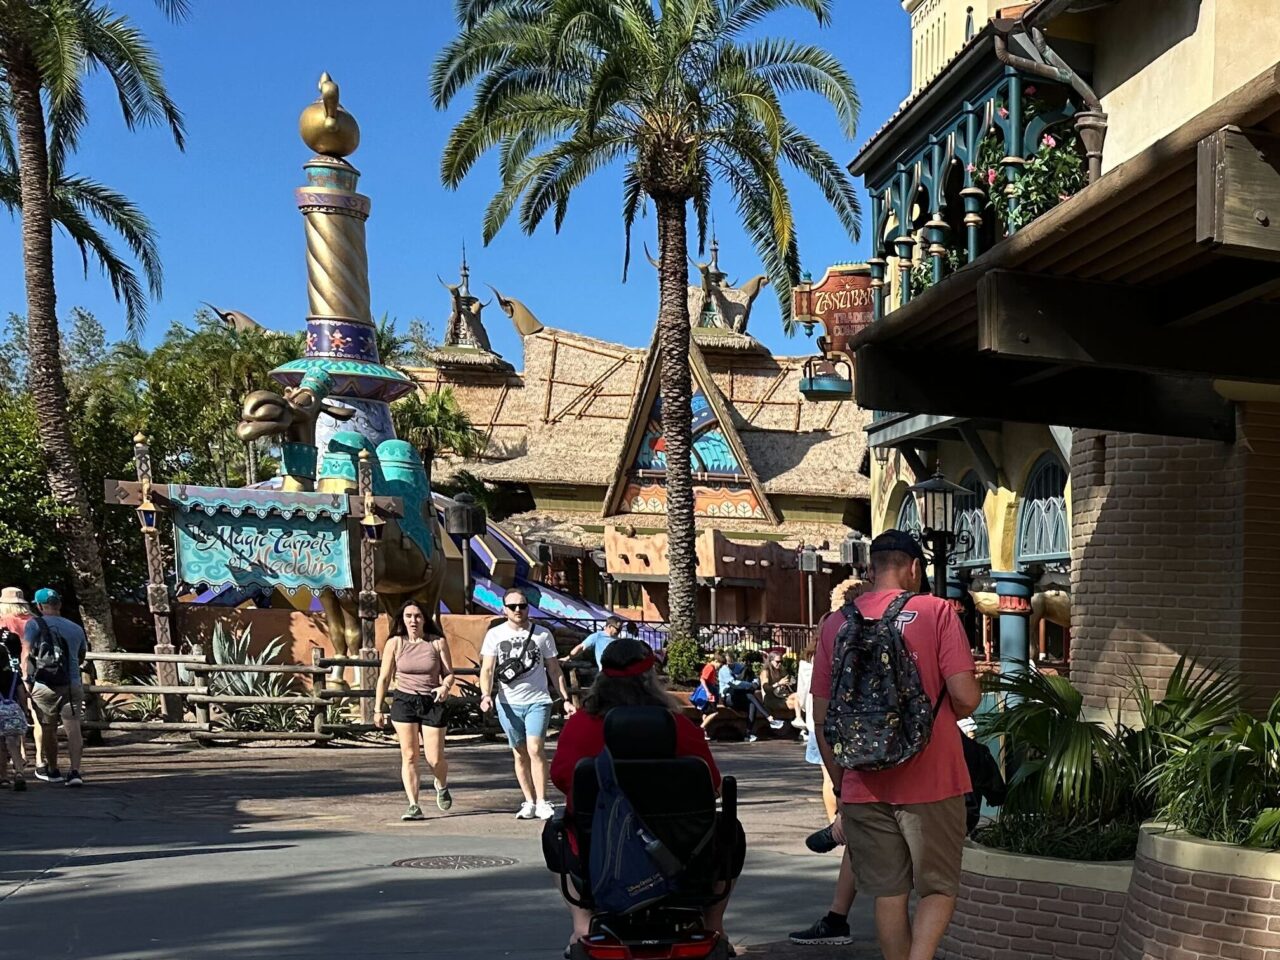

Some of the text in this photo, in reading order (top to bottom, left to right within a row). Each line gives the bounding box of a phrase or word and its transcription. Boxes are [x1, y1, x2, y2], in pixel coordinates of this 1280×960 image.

[815, 288, 874, 314] ZANZIBAR
[185, 520, 335, 557] The Magic Carpets
[228, 546, 337, 577] of Aladdin
